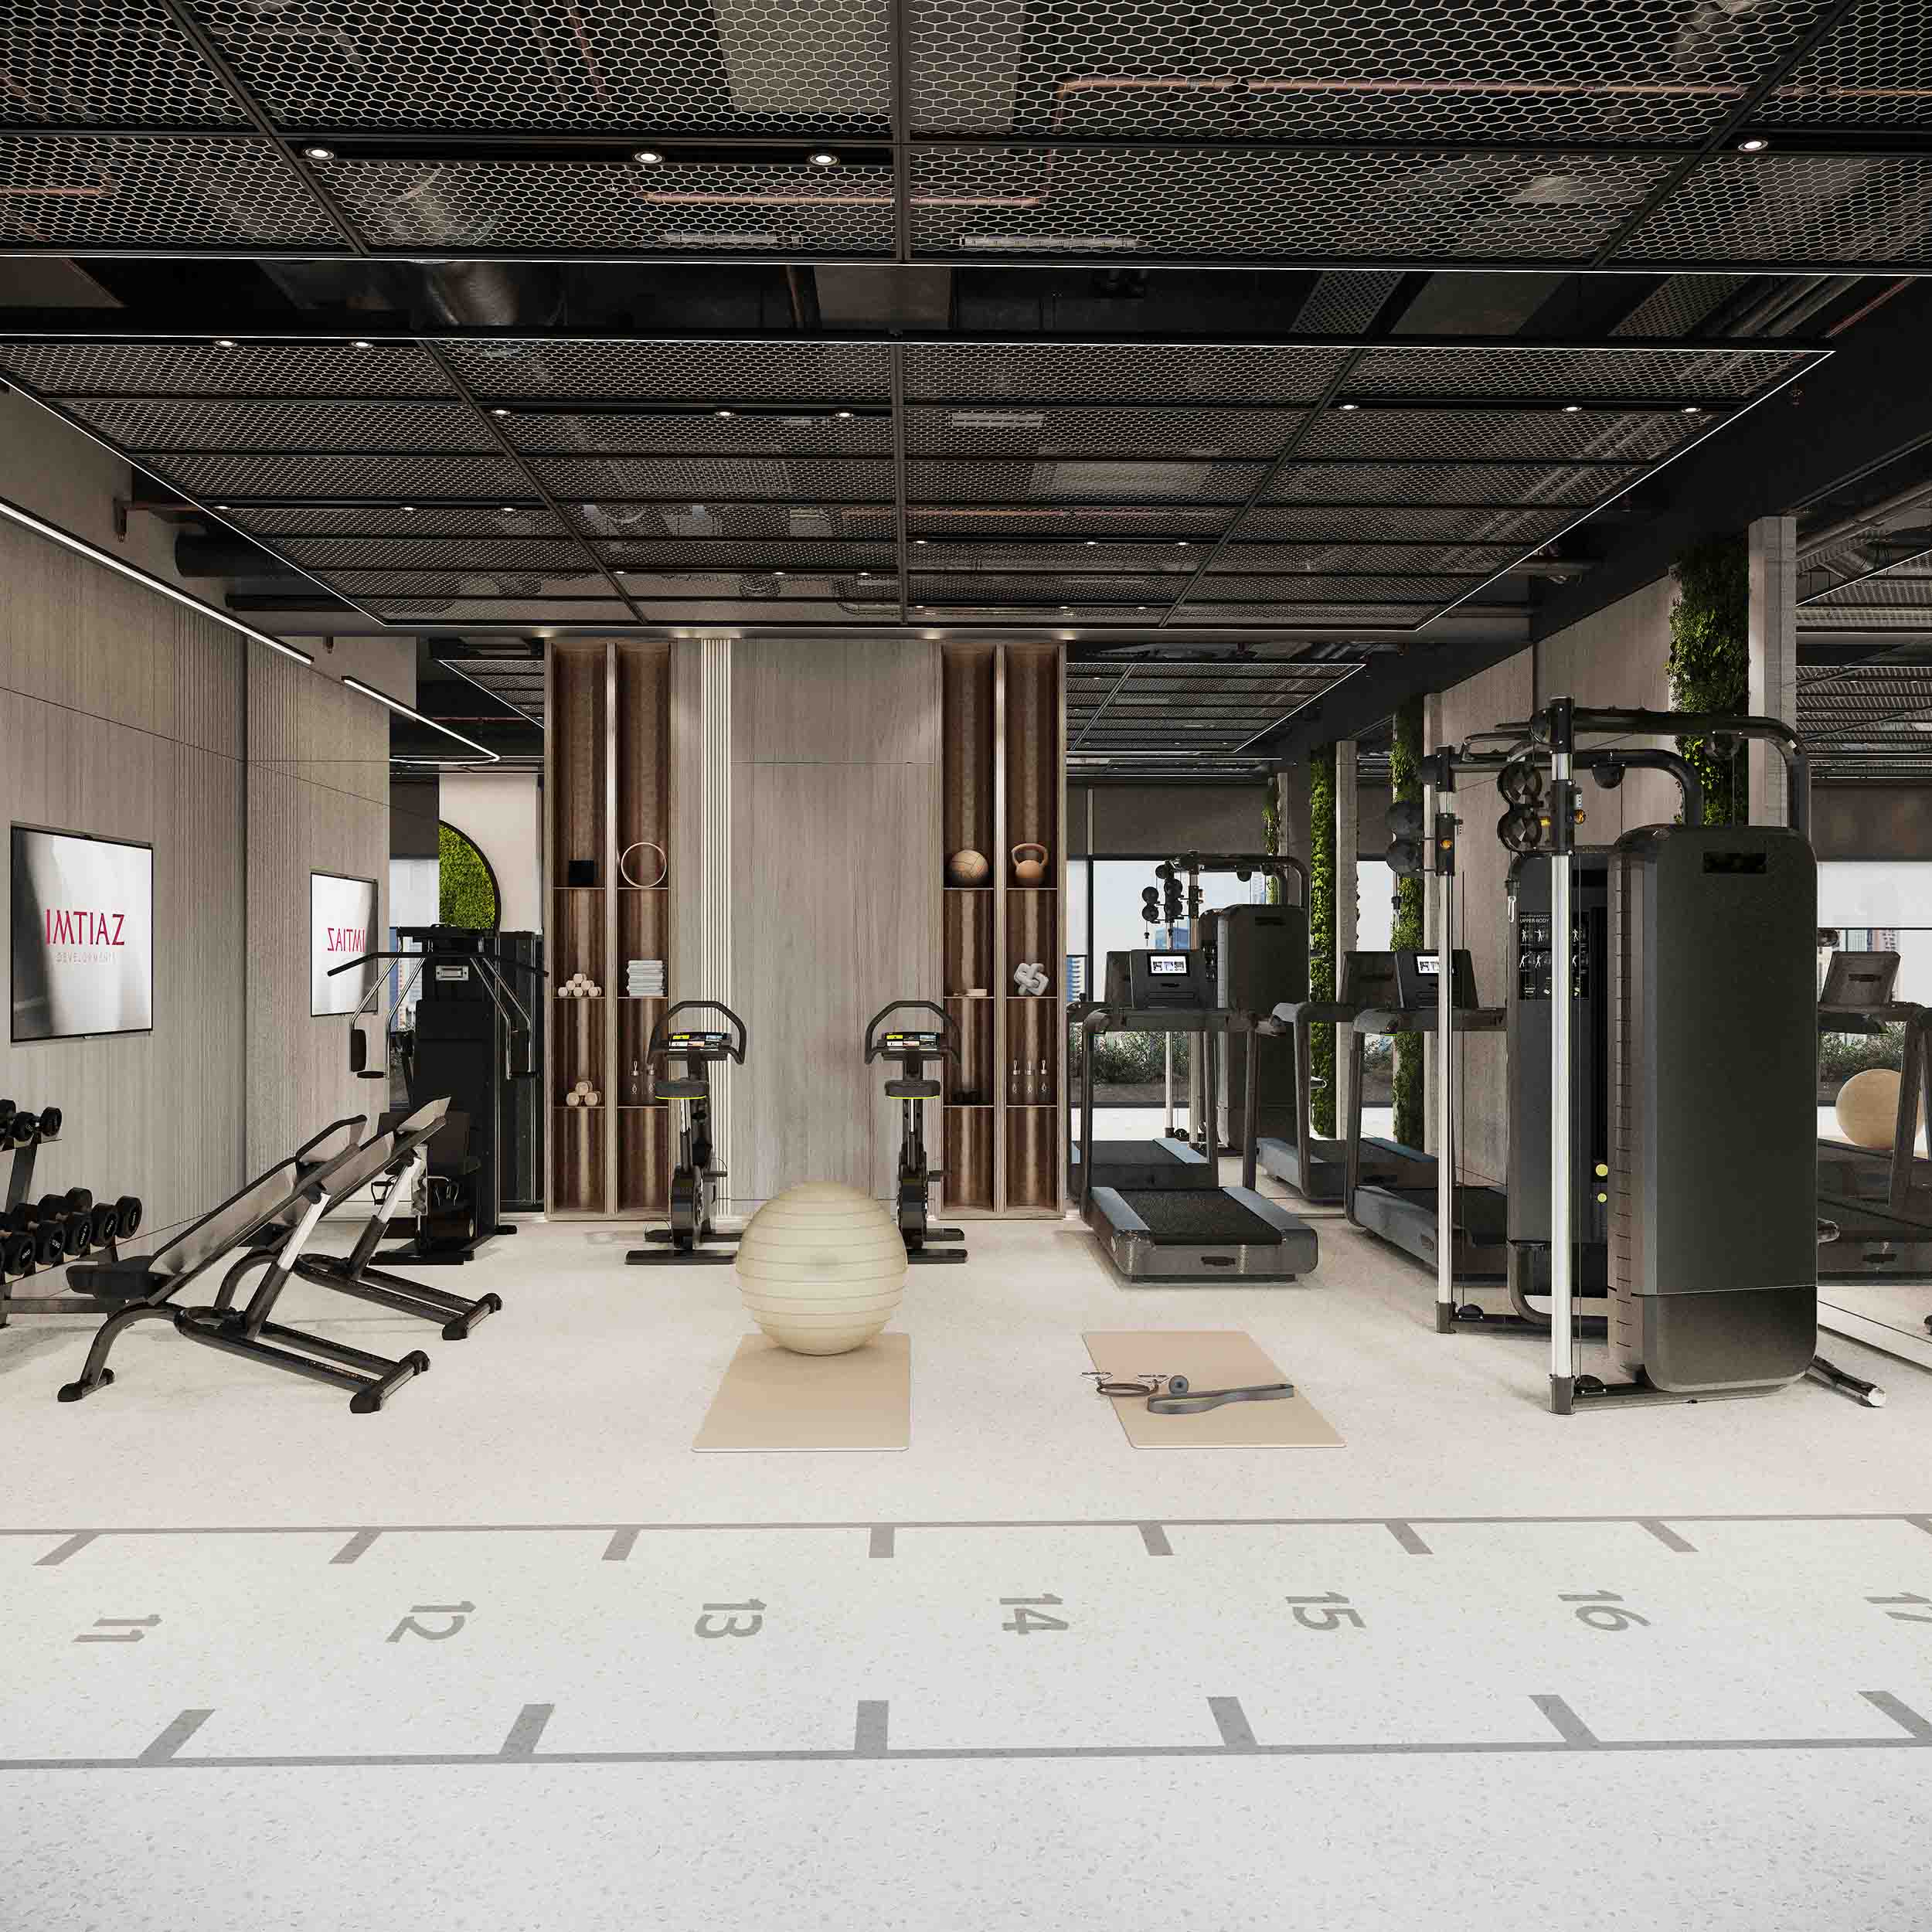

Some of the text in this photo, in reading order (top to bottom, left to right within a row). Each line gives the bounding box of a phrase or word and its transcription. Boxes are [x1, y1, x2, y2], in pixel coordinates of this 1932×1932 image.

[45, 908, 125, 945] IMTIAZ
[73, 1614, 162, 1642] 11
[386, 1600, 476, 1642] 12
[694, 1598, 767, 1638] 13
[1000, 1593, 1069, 1634] 14
[1285, 1591, 1366, 1631] 15
[1558, 1590, 1651, 1631] 16
